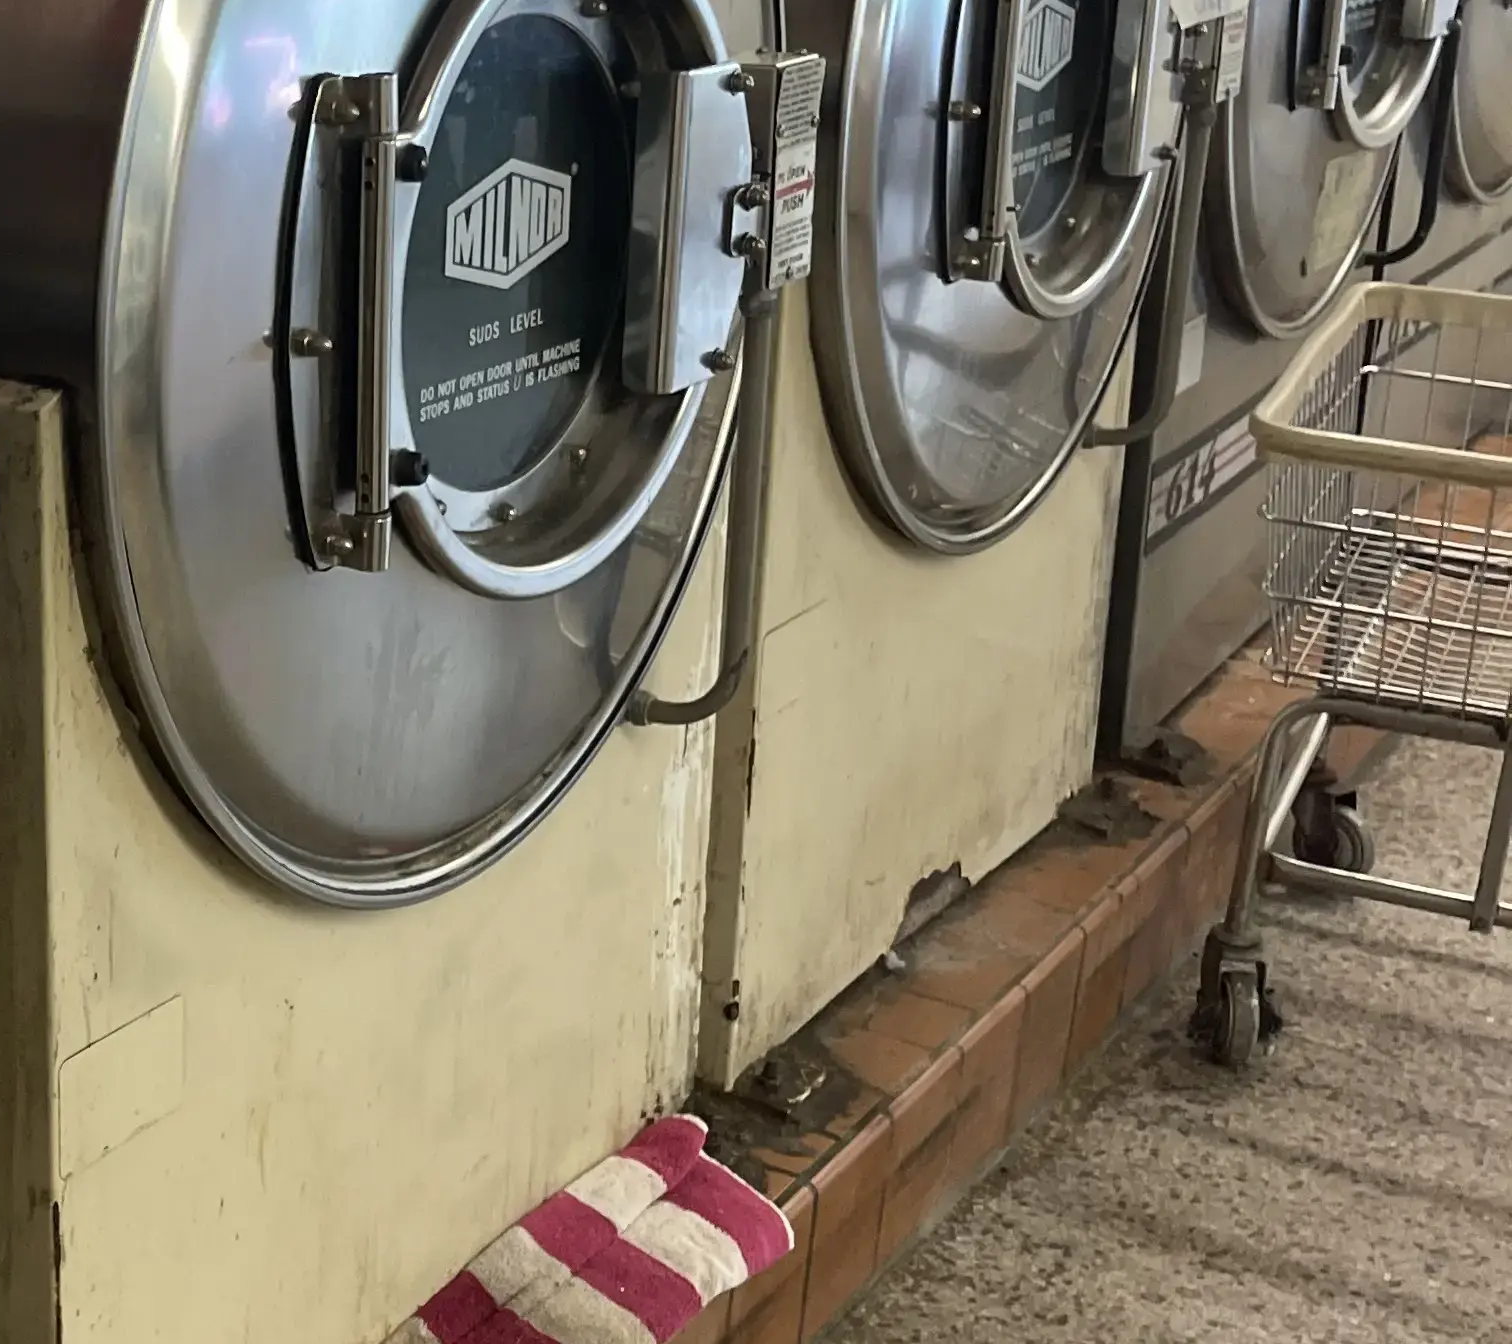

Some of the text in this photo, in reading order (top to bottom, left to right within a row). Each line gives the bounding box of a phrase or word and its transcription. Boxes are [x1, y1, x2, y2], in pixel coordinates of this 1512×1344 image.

[454, 173, 564, 275] MILNOR
[469, 308, 544, 347] SUDS LEVEL
[419, 399, 451, 423] STOPS
[453, 391, 474, 411] AND
[477, 379, 510, 404] STATUS
[525, 371, 535, 388] IS
[537, 356, 581, 383] FLASHING
[420, 338, 581, 404] DO NOT OPEN DOOR UNTIL MACHINE
